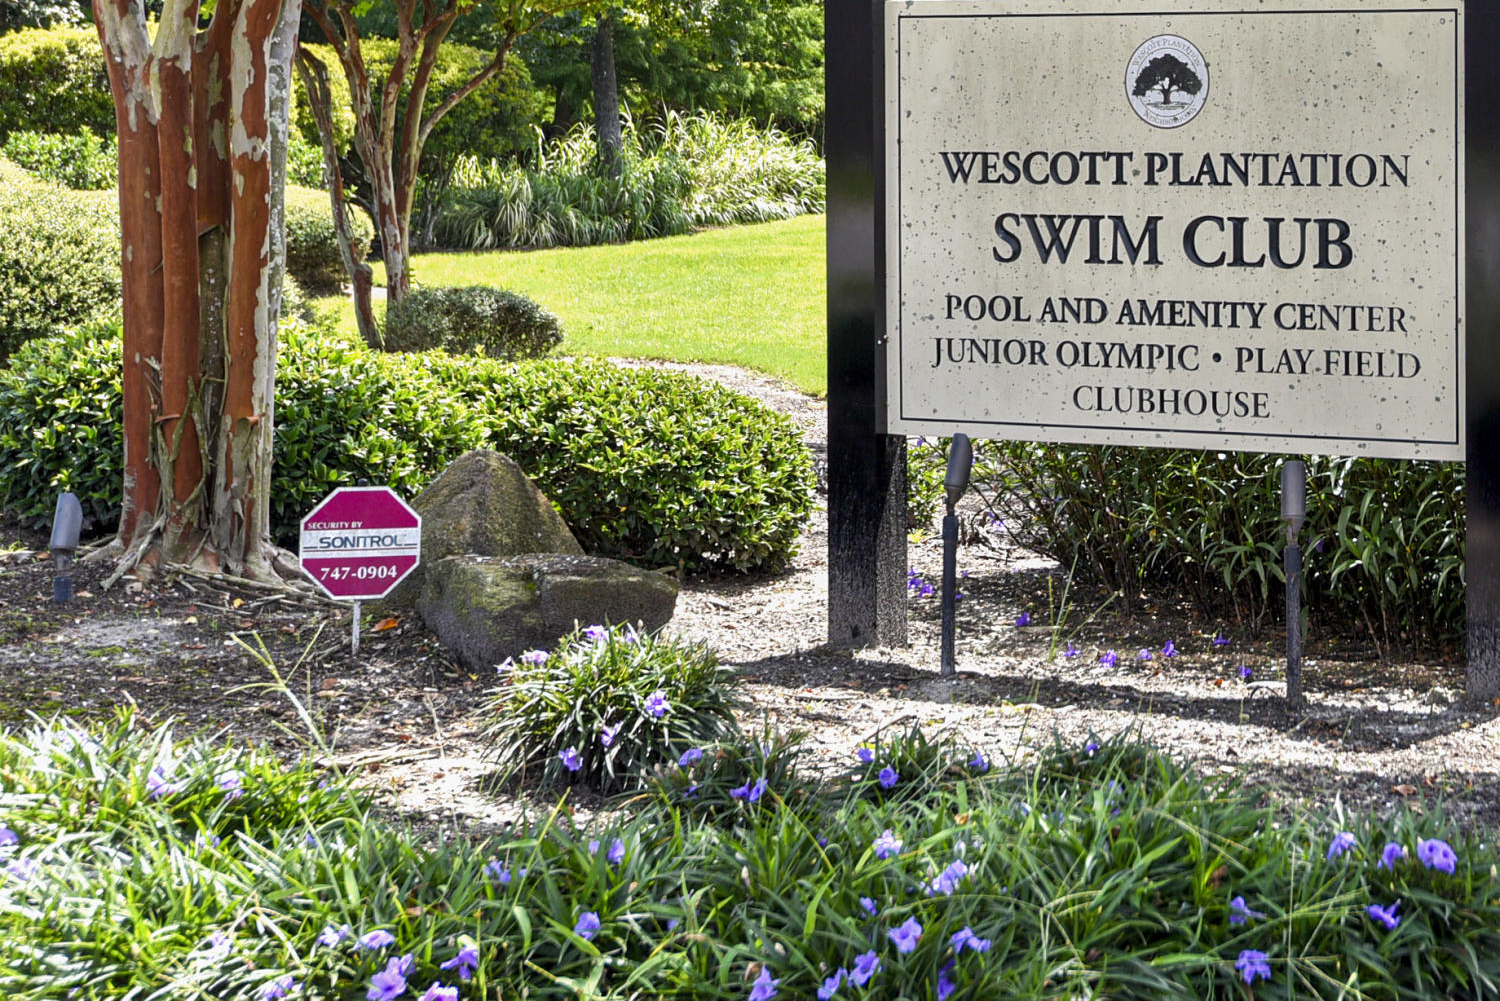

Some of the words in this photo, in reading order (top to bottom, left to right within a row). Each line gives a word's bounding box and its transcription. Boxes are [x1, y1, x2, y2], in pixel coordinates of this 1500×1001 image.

[939, 151, 1133, 185] WESCOTT
[1144, 152, 1411, 187] PLANTATION
[992, 212, 1164, 265] SWIM
[1182, 215, 1353, 269] CLUB
[944, 295, 1032, 322] POOL
[1040, 297, 1108, 324] AND
[1115, 298, 1267, 329] AMENITY
[1273, 302, 1408, 333] CENTER
[931, 337, 1049, 368] JUNIOR
[1056, 340, 1200, 371] OLYMPIC
[1235, 347, 1315, 375] PLAY
[1323, 350, 1422, 378] FIELD
[1072, 385, 1270, 418] CLUBHOUSE
[307, 521, 349, 530] SECURITY
[319, 535, 402, 548] SONITROL
[320, 565, 397, 580] 747-0904
